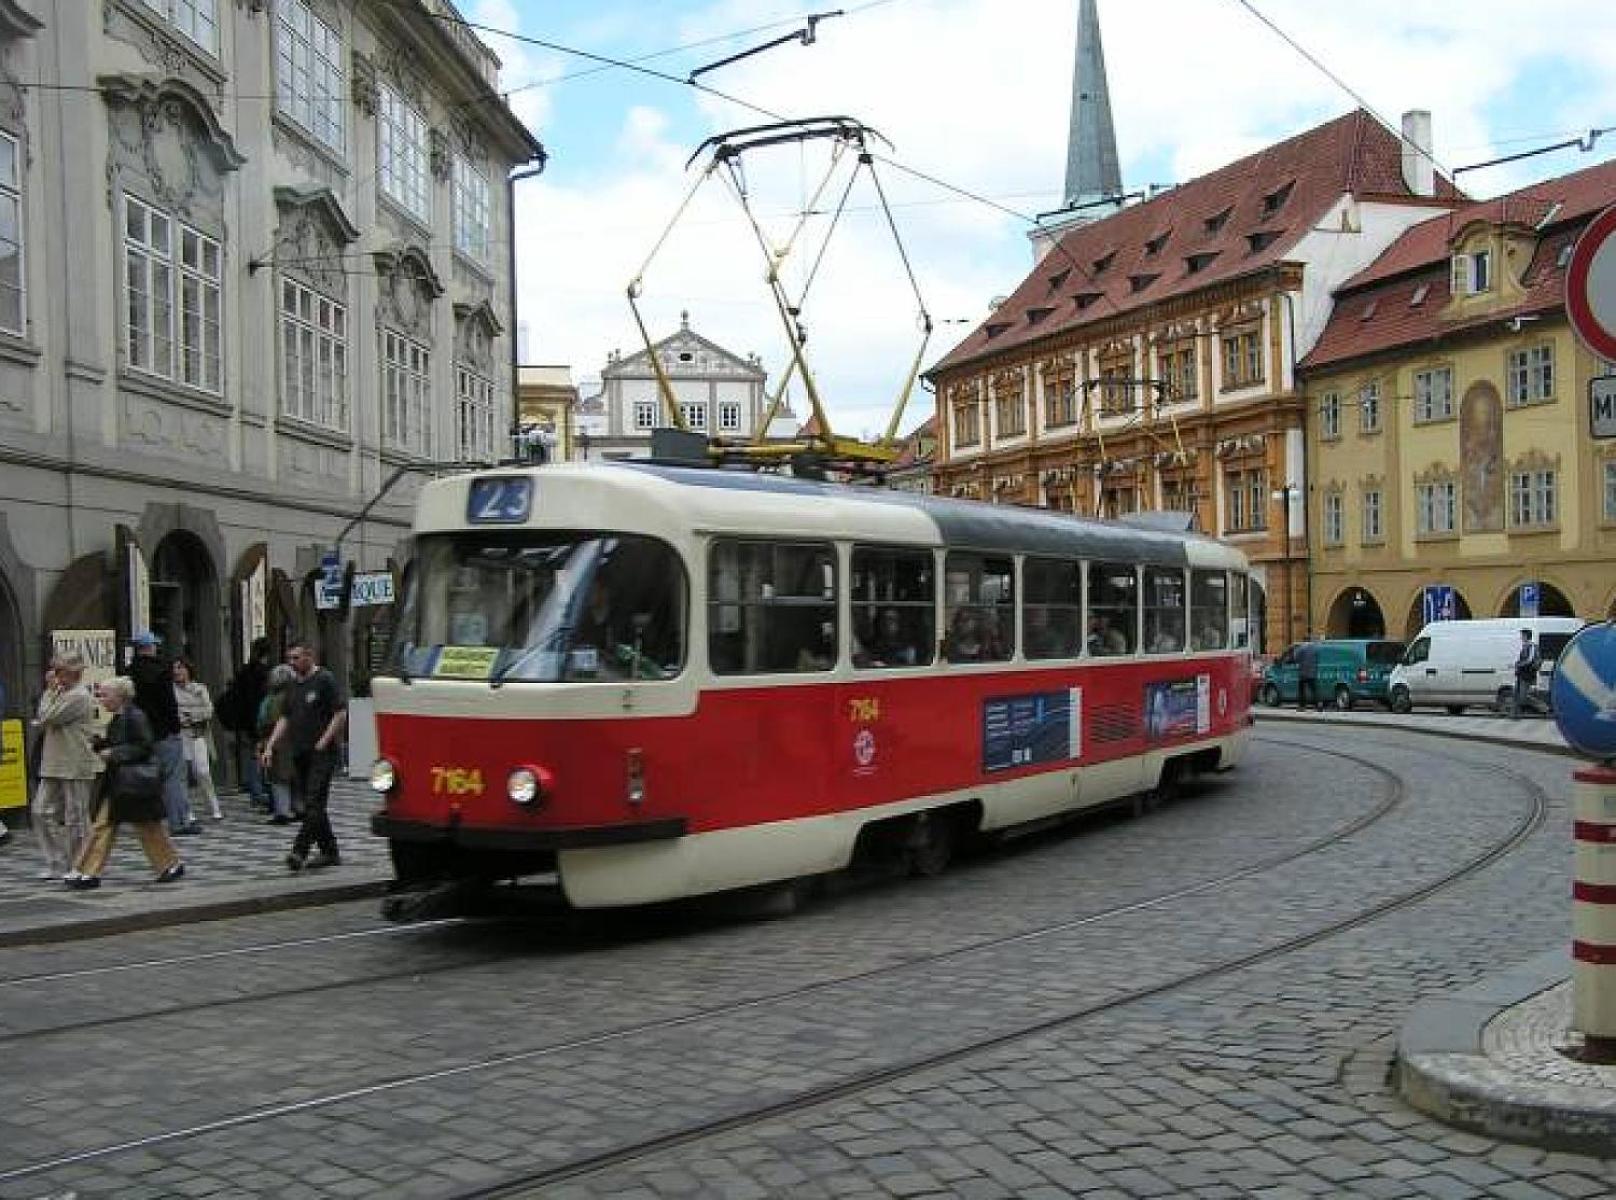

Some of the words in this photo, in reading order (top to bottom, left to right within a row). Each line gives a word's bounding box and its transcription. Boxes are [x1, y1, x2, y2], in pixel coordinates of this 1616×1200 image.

[477, 484, 529, 517] 23
[849, 697, 879, 721] 7164
[430, 766, 486, 796] 7164
